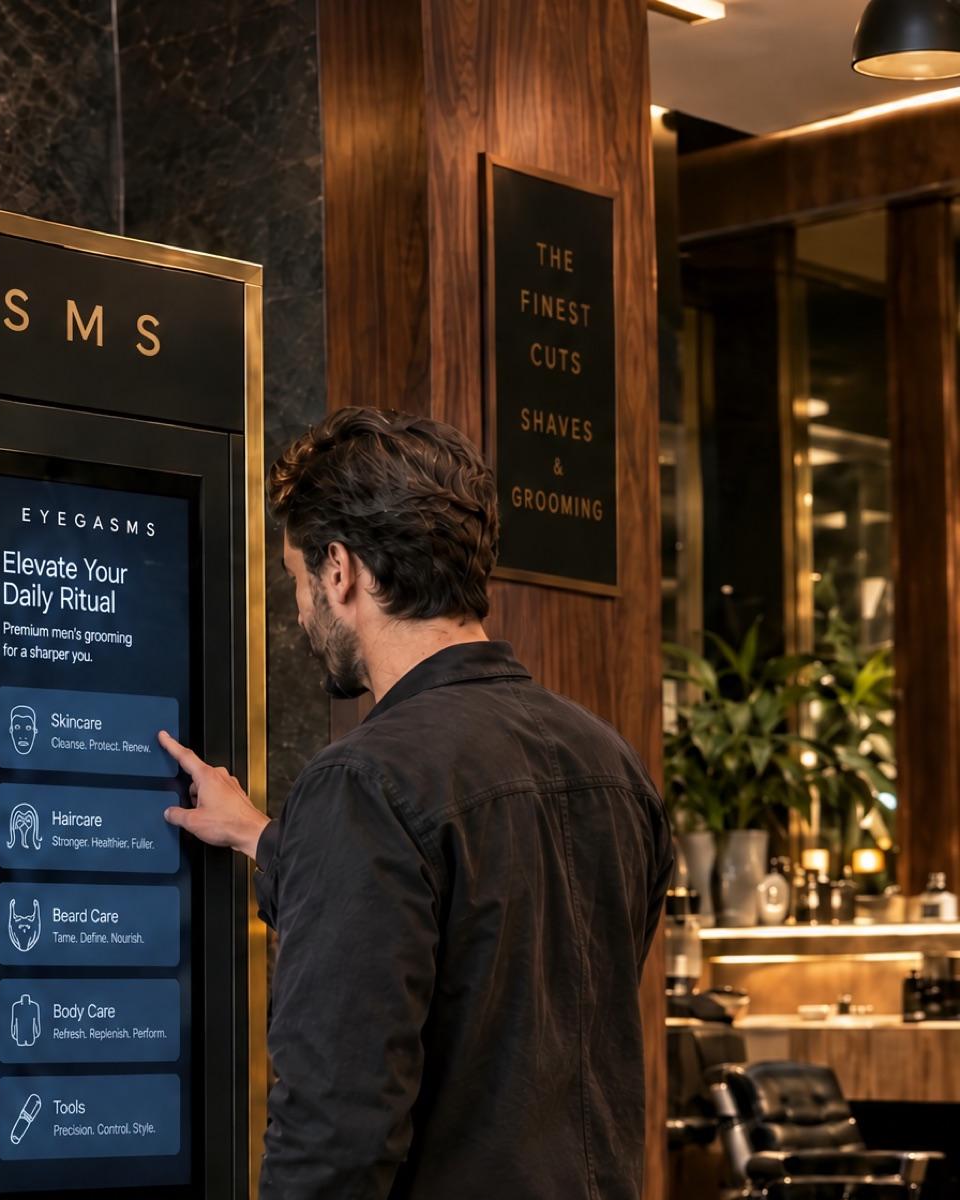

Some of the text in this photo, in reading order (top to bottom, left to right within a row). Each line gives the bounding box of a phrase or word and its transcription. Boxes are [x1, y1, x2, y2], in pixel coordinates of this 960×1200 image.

[537, 242, 573, 272] THE
[521, 290, 590, 328] FINEST
[531, 343, 580, 374] CUTS
[521, 408, 592, 442] SHAVES
[552, 457, 563, 476] &
[512, 486, 602, 520] GROOMING
[22, 508, 154, 536] EYEGASMS
[4, 551, 128, 584] Elevate Your
[4, 582, 115, 614] Daily Ritual
[4, 622, 132, 647] Premium men's grooming
[3, 643, 92, 663] for a sharper you.
[51, 713, 102, 730] Skincare
[90, 739, 120, 751] Protect.
[52, 811, 102, 826] Haircare
[53, 908, 118, 923] Beard Care
[54, 1004, 115, 1021] Body Care
[133, 1028, 166, 1038] Perform.
[53, 1100, 85, 1114] Tools
